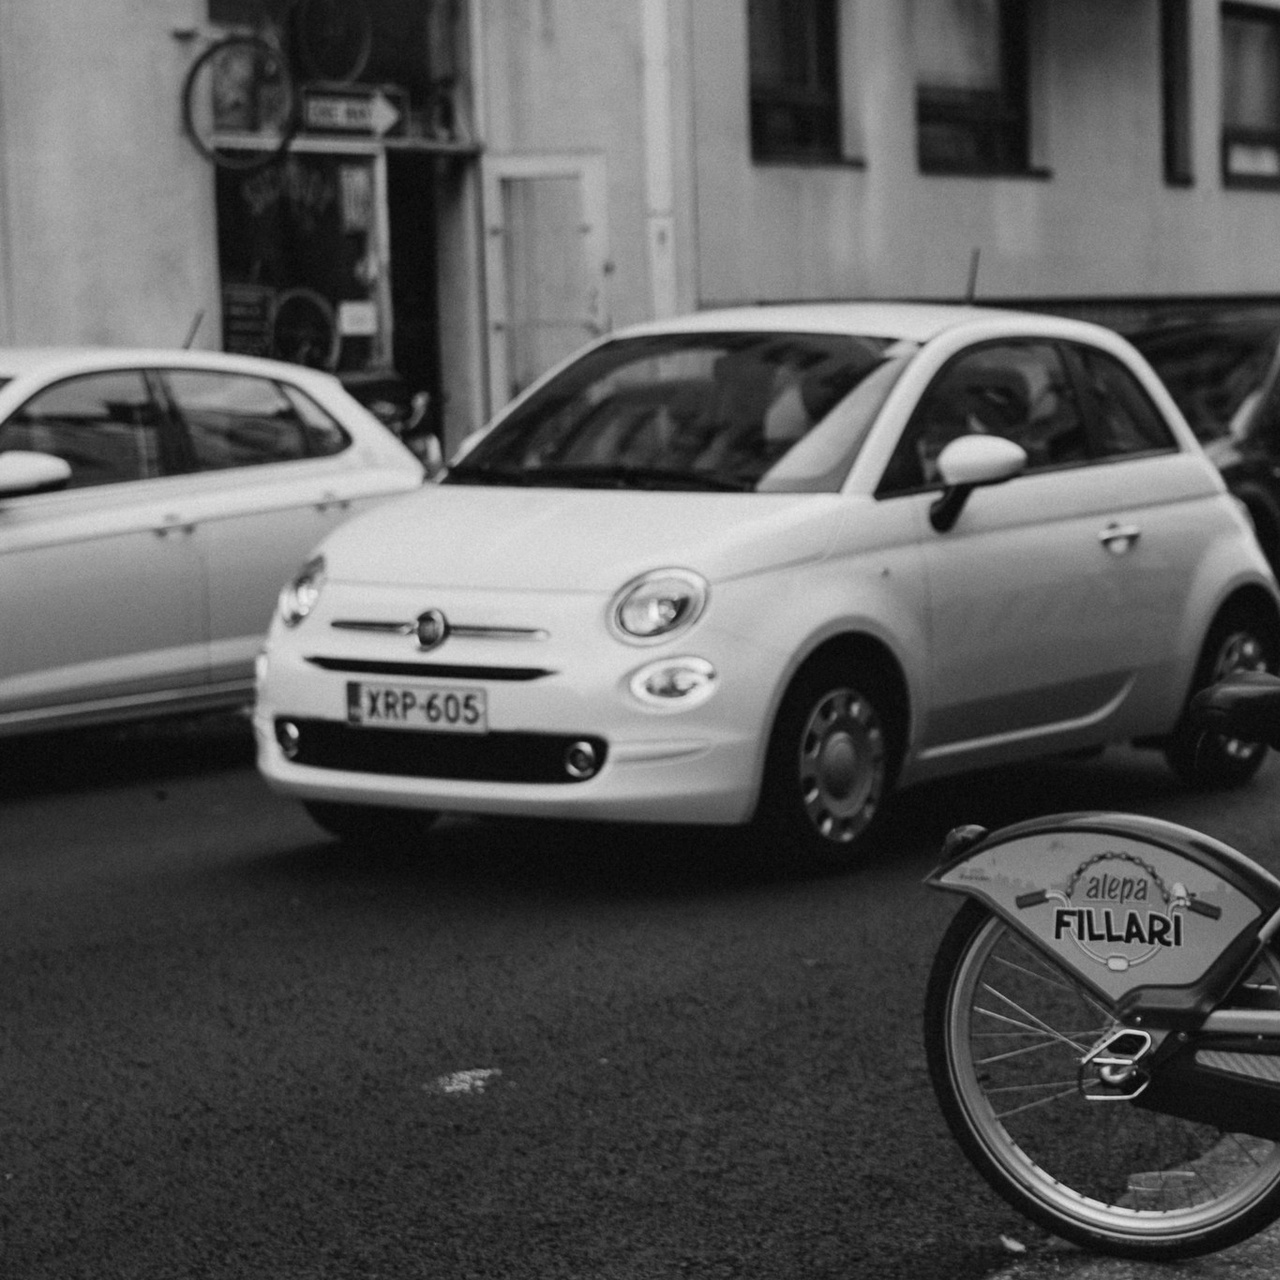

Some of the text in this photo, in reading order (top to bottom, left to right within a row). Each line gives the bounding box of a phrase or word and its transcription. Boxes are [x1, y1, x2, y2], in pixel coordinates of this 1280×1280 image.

[367, 689, 480, 725] XRP-605
[1086, 873, 1148, 904] alepa
[1054, 908, 1182, 948] FILLARI
